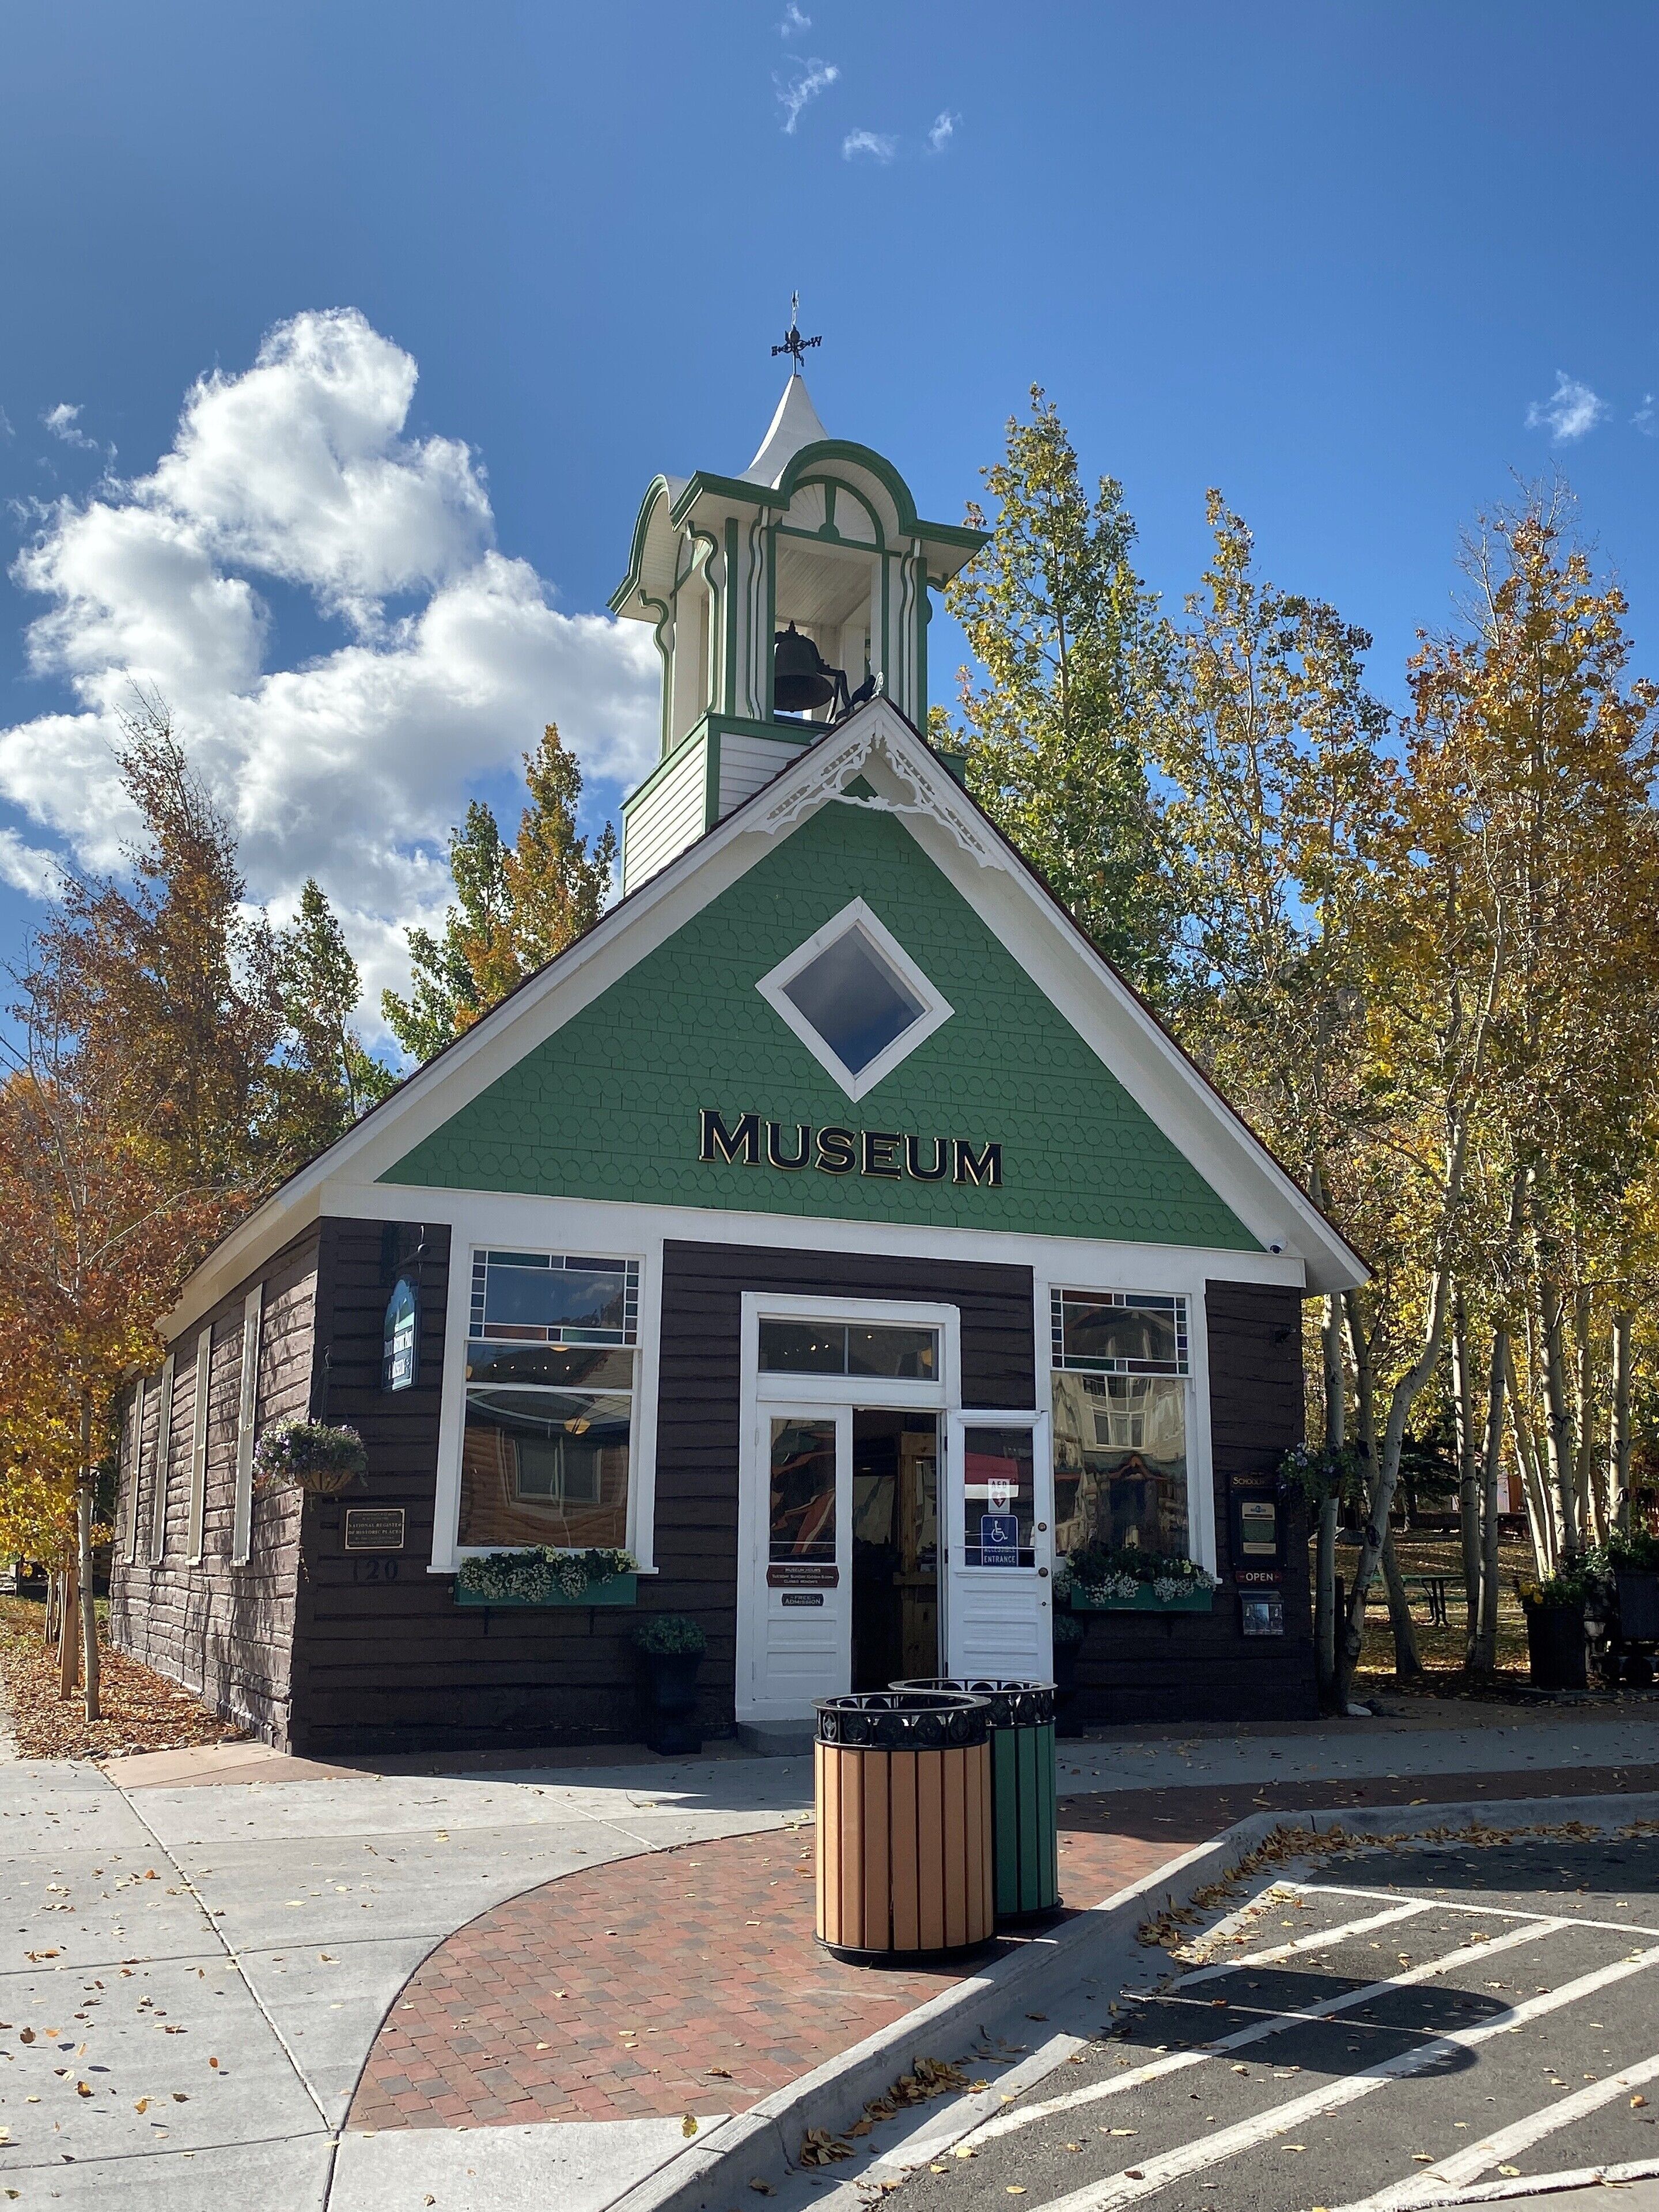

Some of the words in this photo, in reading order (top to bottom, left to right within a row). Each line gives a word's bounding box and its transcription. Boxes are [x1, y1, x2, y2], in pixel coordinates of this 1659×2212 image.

[699, 1108, 1003, 1187] MUSEUM
[991, 1480, 1007, 1488] AED
[984, 1555, 1016, 1563] ENTRANCE
[1246, 1573, 1273, 1581] OPEN
